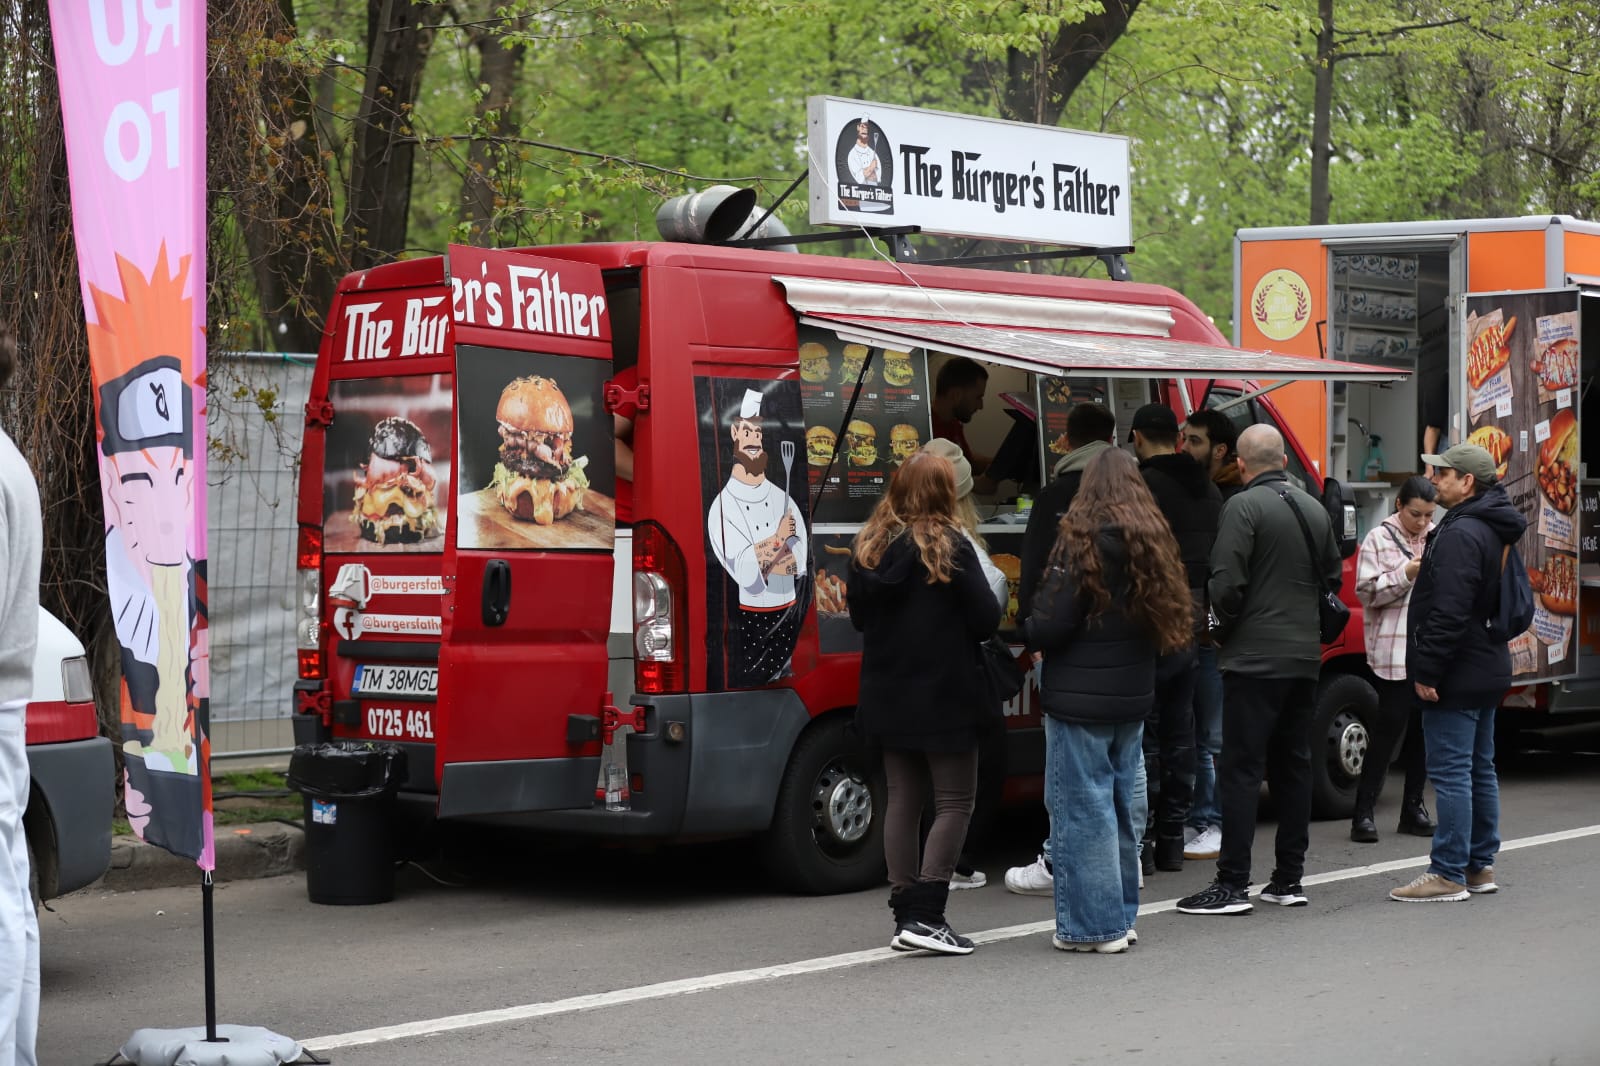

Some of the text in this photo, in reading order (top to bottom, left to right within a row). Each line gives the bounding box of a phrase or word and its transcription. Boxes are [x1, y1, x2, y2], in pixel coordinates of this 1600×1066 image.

[840, 184, 893, 201] The Burger's Father
[899, 144, 1120, 216] The Burger's Father
[508, 264, 605, 337] Father
[343, 302, 393, 362] The
[362, 668, 384, 690] TM
[368, 708, 434, 738] 0725 461
